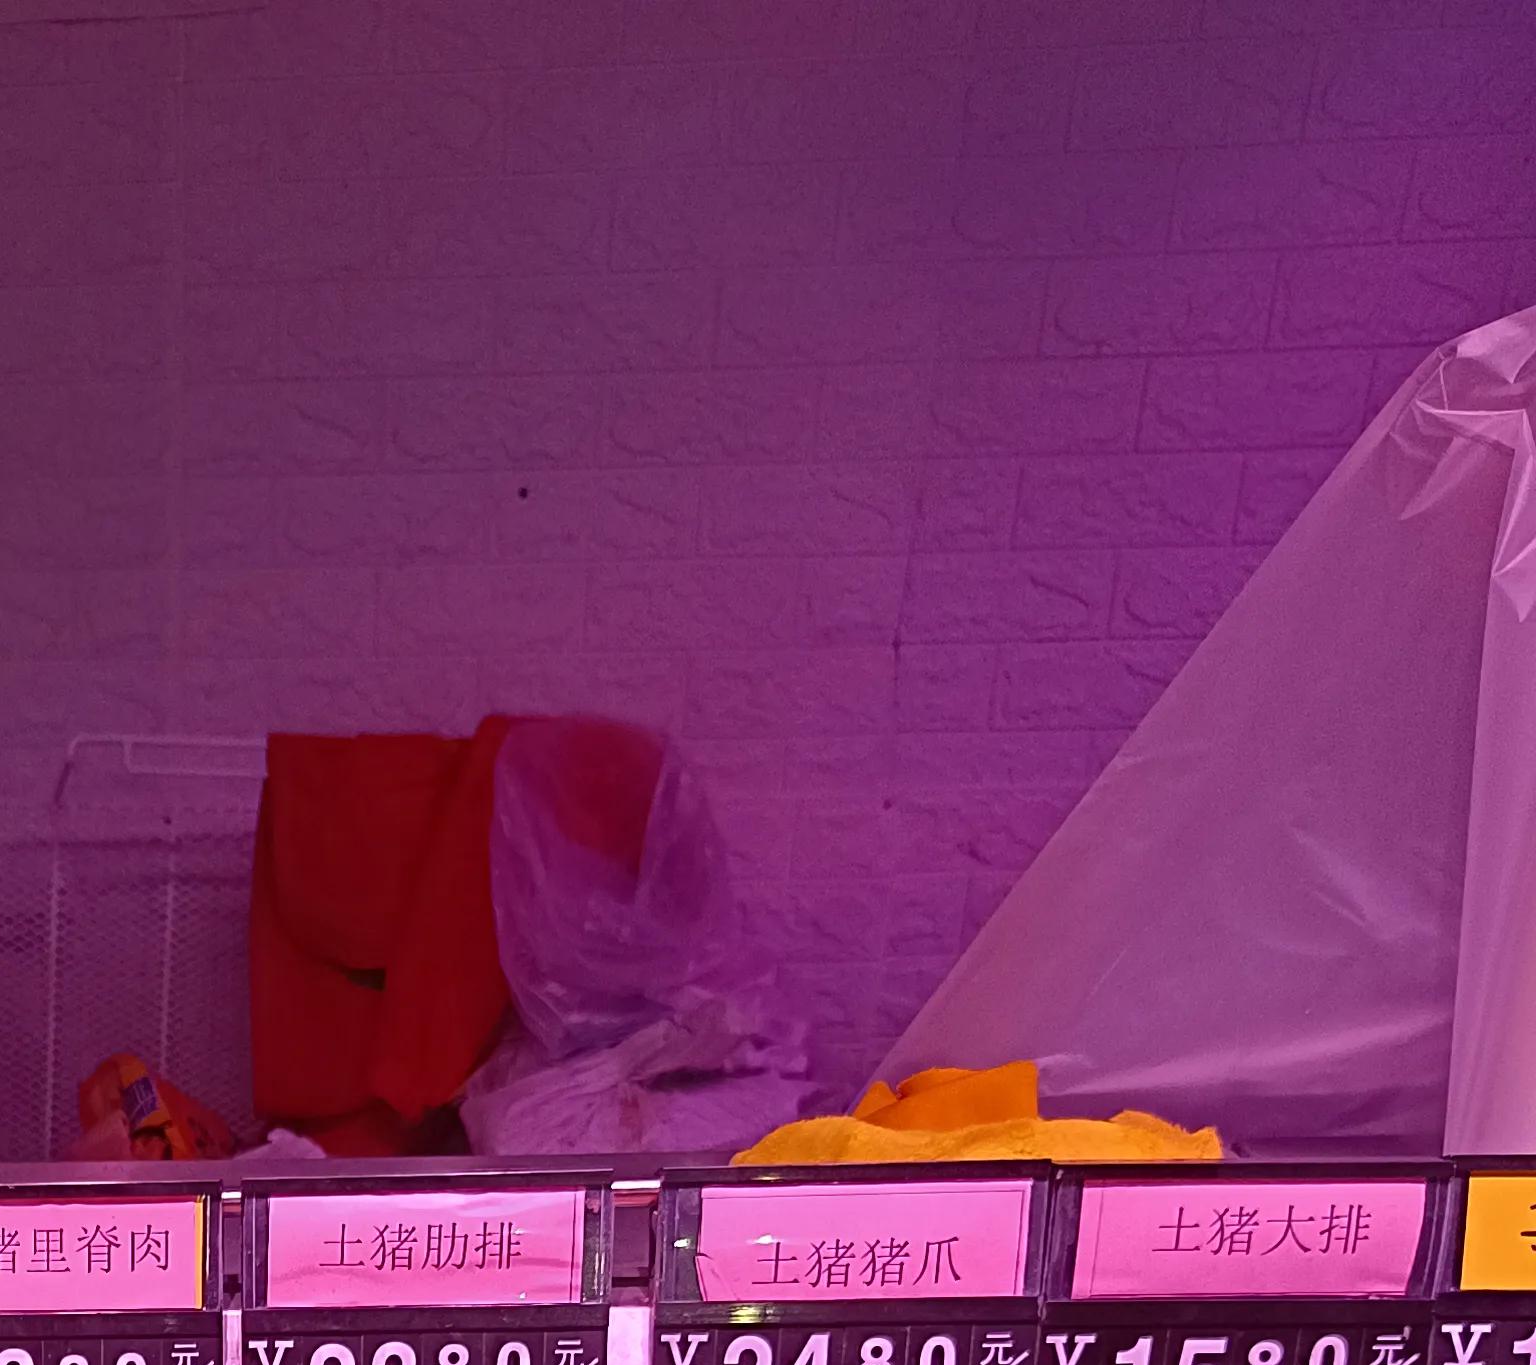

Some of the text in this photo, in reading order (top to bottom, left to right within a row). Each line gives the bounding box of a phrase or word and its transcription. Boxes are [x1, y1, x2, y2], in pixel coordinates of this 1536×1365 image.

[318, 1221, 523, 1272] 土猪肋排
[1152, 1204, 1372, 1257] 土猪大排
[751, 1236, 962, 1289] 土猪猪爪
